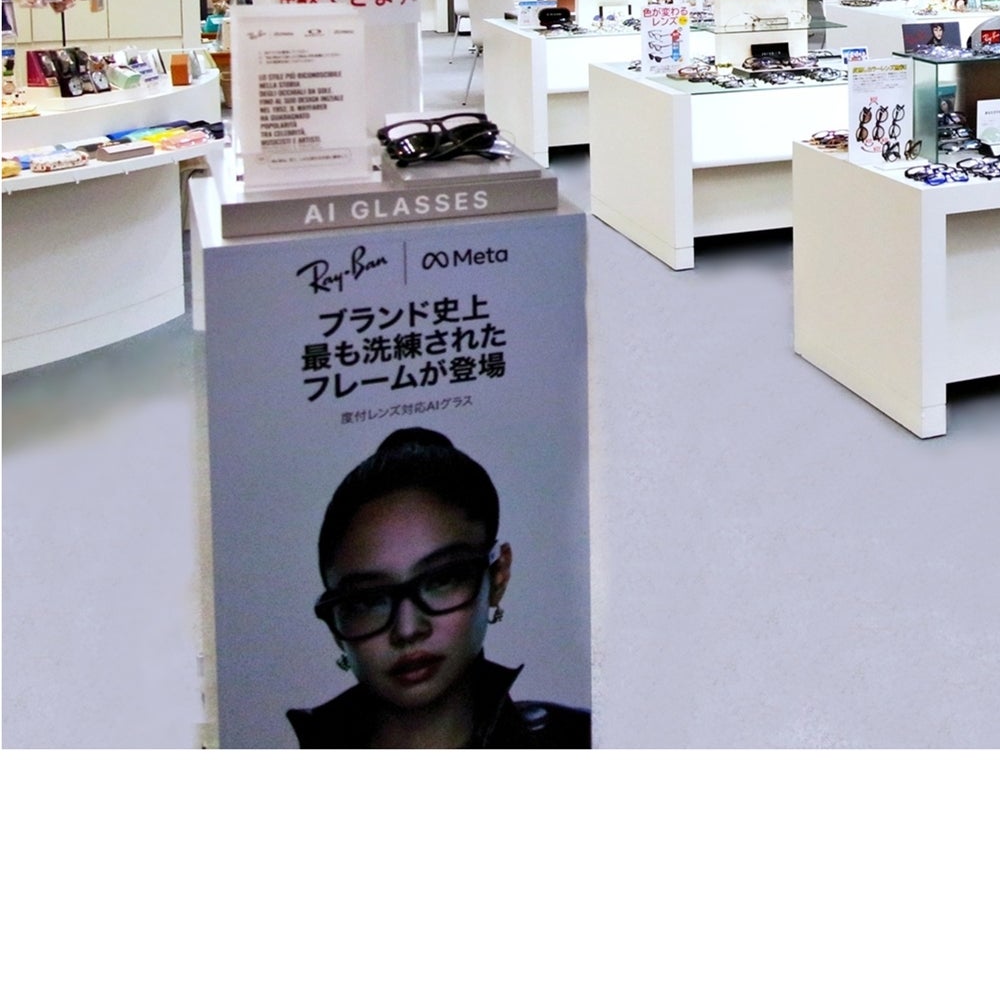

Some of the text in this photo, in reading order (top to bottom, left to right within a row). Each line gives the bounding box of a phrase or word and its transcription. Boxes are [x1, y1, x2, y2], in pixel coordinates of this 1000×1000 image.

[643, 6, 688, 18] 色が変わる
[652, 16, 678, 27] レンズ
[304, 190, 489, 225] AI GLASSES
[296, 245, 509, 294] Ray-Ban Meta
[319, 294, 490, 338] ブランド史上
[301, 323, 507, 373] 最も洗練された
[303, 351, 506, 402] フレームが登場
[340, 395, 474, 425] 度付レンズ対応AIグラス
